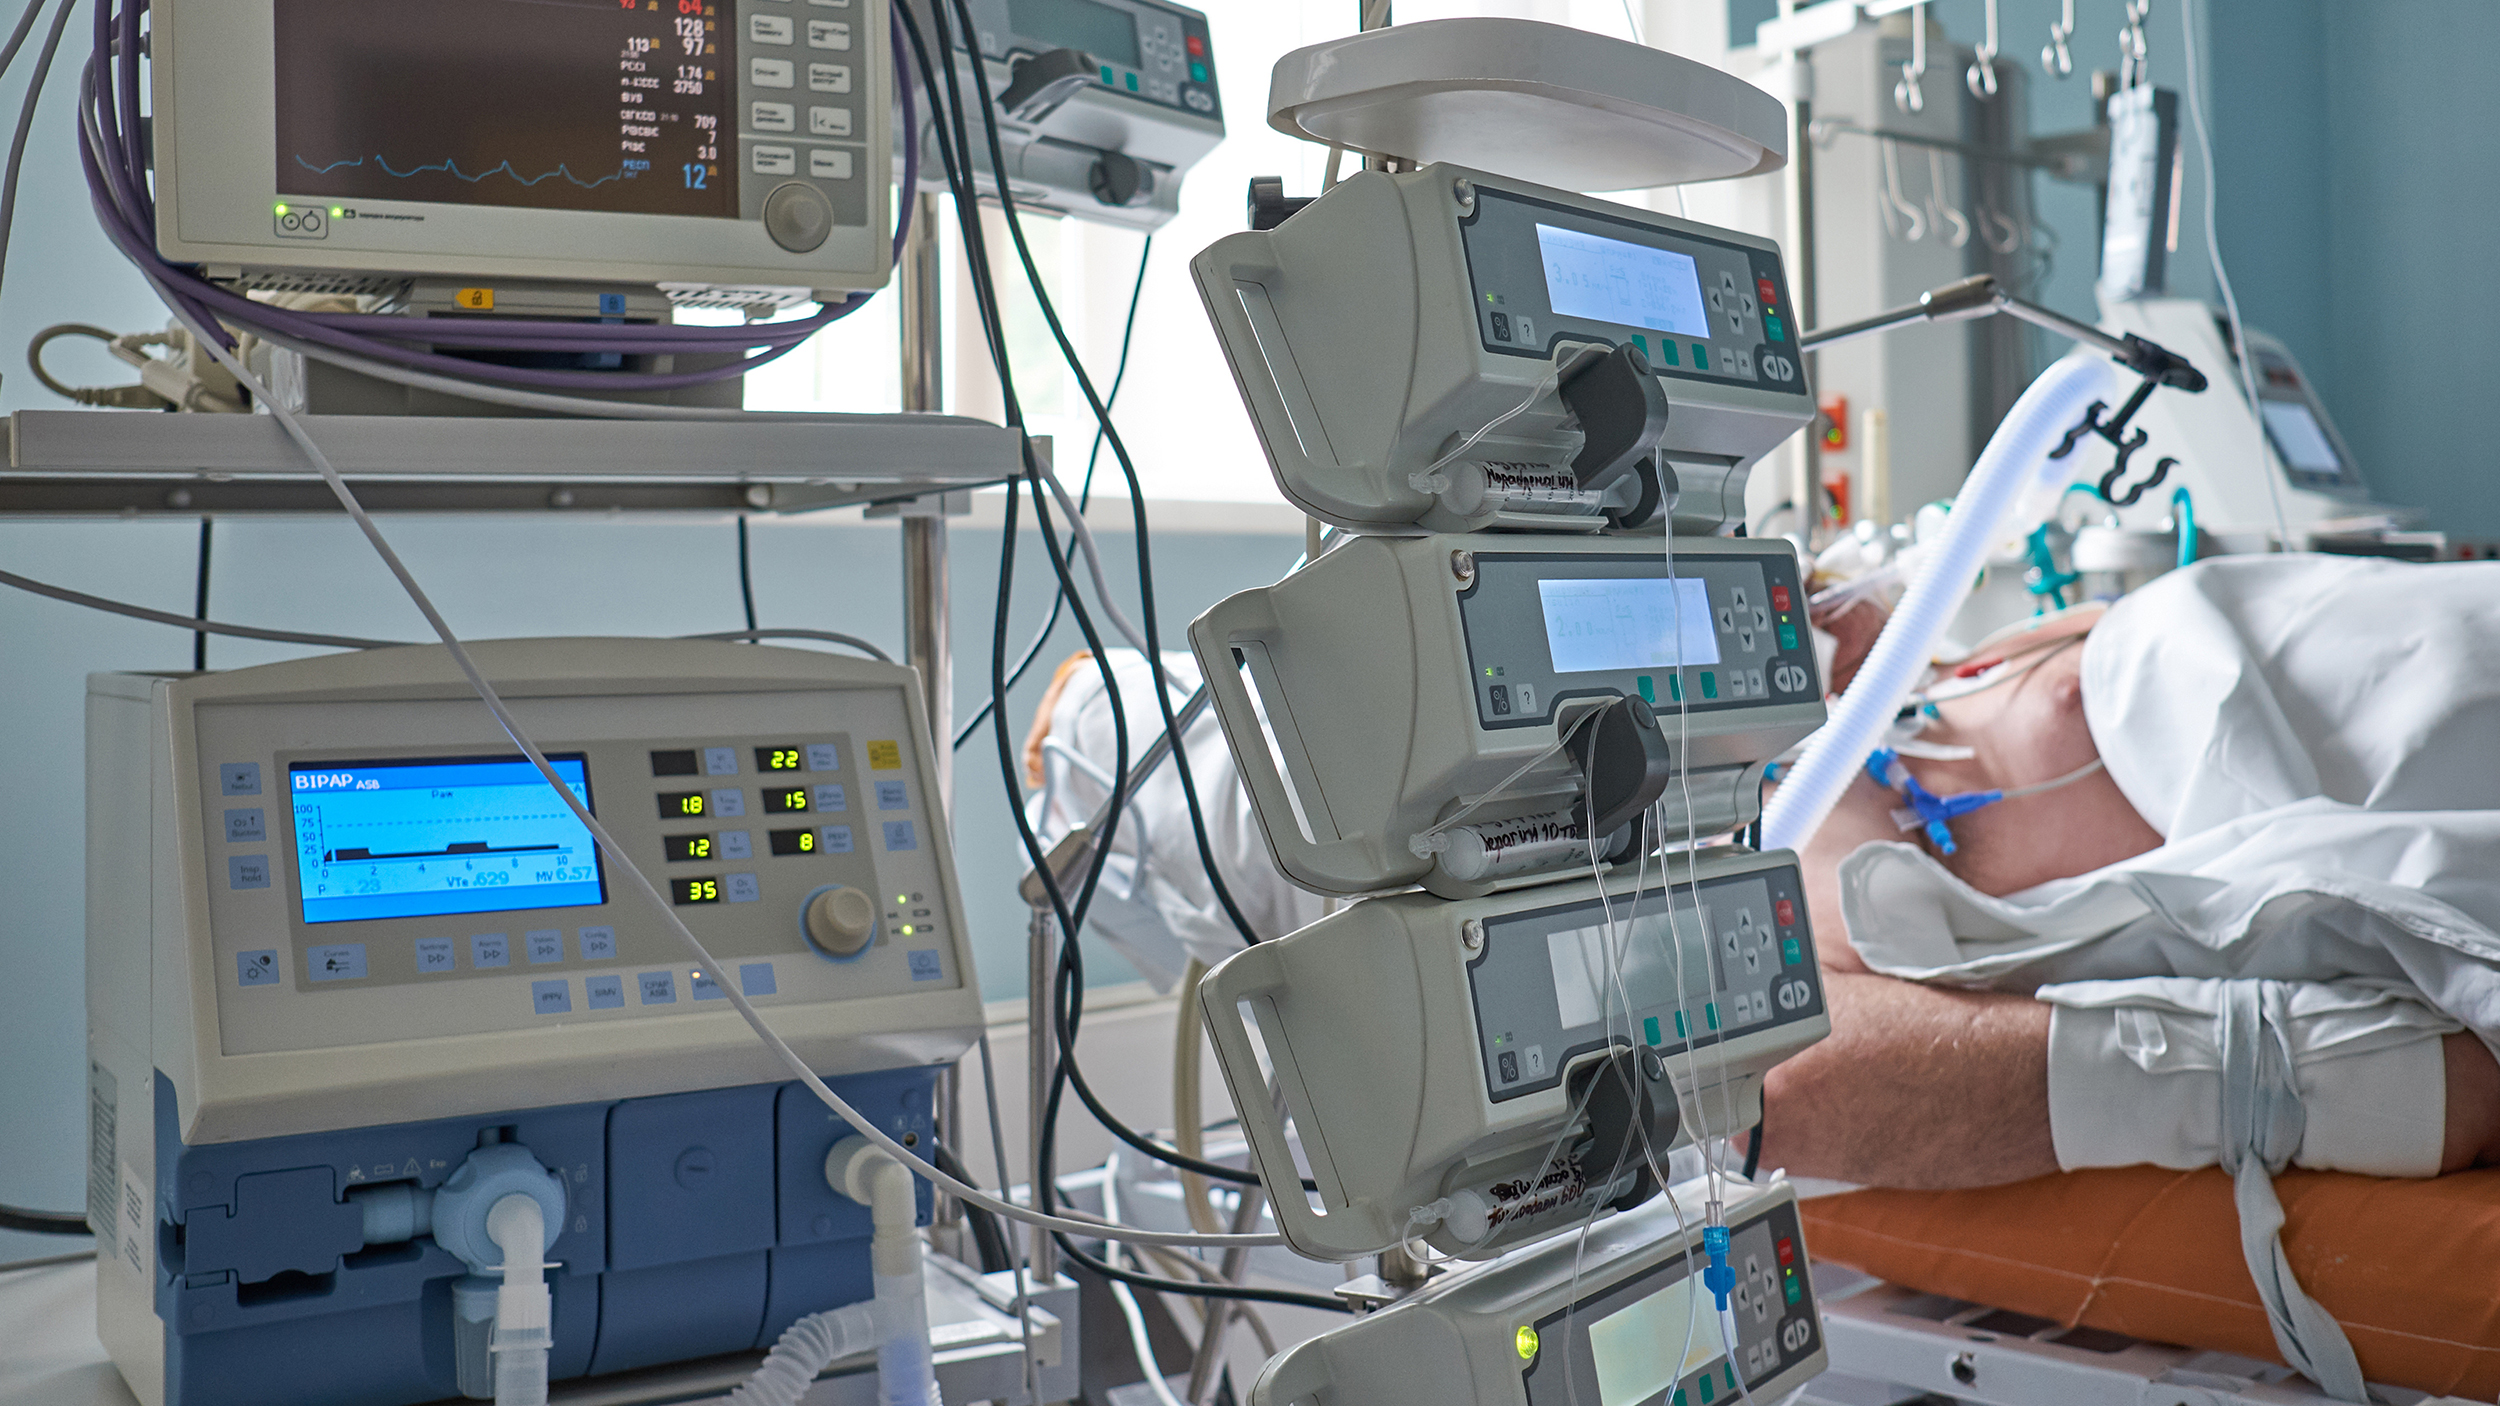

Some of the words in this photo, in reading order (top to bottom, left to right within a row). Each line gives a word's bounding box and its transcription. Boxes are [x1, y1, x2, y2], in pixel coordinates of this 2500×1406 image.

[674, 17, 704, 37] 128
[627, 37, 650, 52] 113
[682, 38, 705, 56] 97
[709, 131, 717, 144] 7
[683, 163, 707, 190] 12
[770, 750, 799, 769] 22
[295, 773, 354, 790] BIPAP
[356, 779, 381, 791] ASB
[295, 804, 313, 814] 100
[785, 791, 807, 809] 15
[302, 817, 315, 828] 75
[302, 832, 316, 842] 50
[799, 833, 814, 852] 8
[304, 845, 317, 855] 25
[688, 838, 711, 857] 12
[312, 859, 319, 868] 0
[322, 869, 329, 879] 0
[370, 866, 377, 876] 2
[418, 863, 426, 874] 4
[465, 859, 473, 871] 6
[511, 857, 519, 869] 8
[556, 855, 568, 866] 10
[535, 871, 554, 883] MV
[555, 866, 593, 881] 6.57
[689, 881, 717, 901] 35
